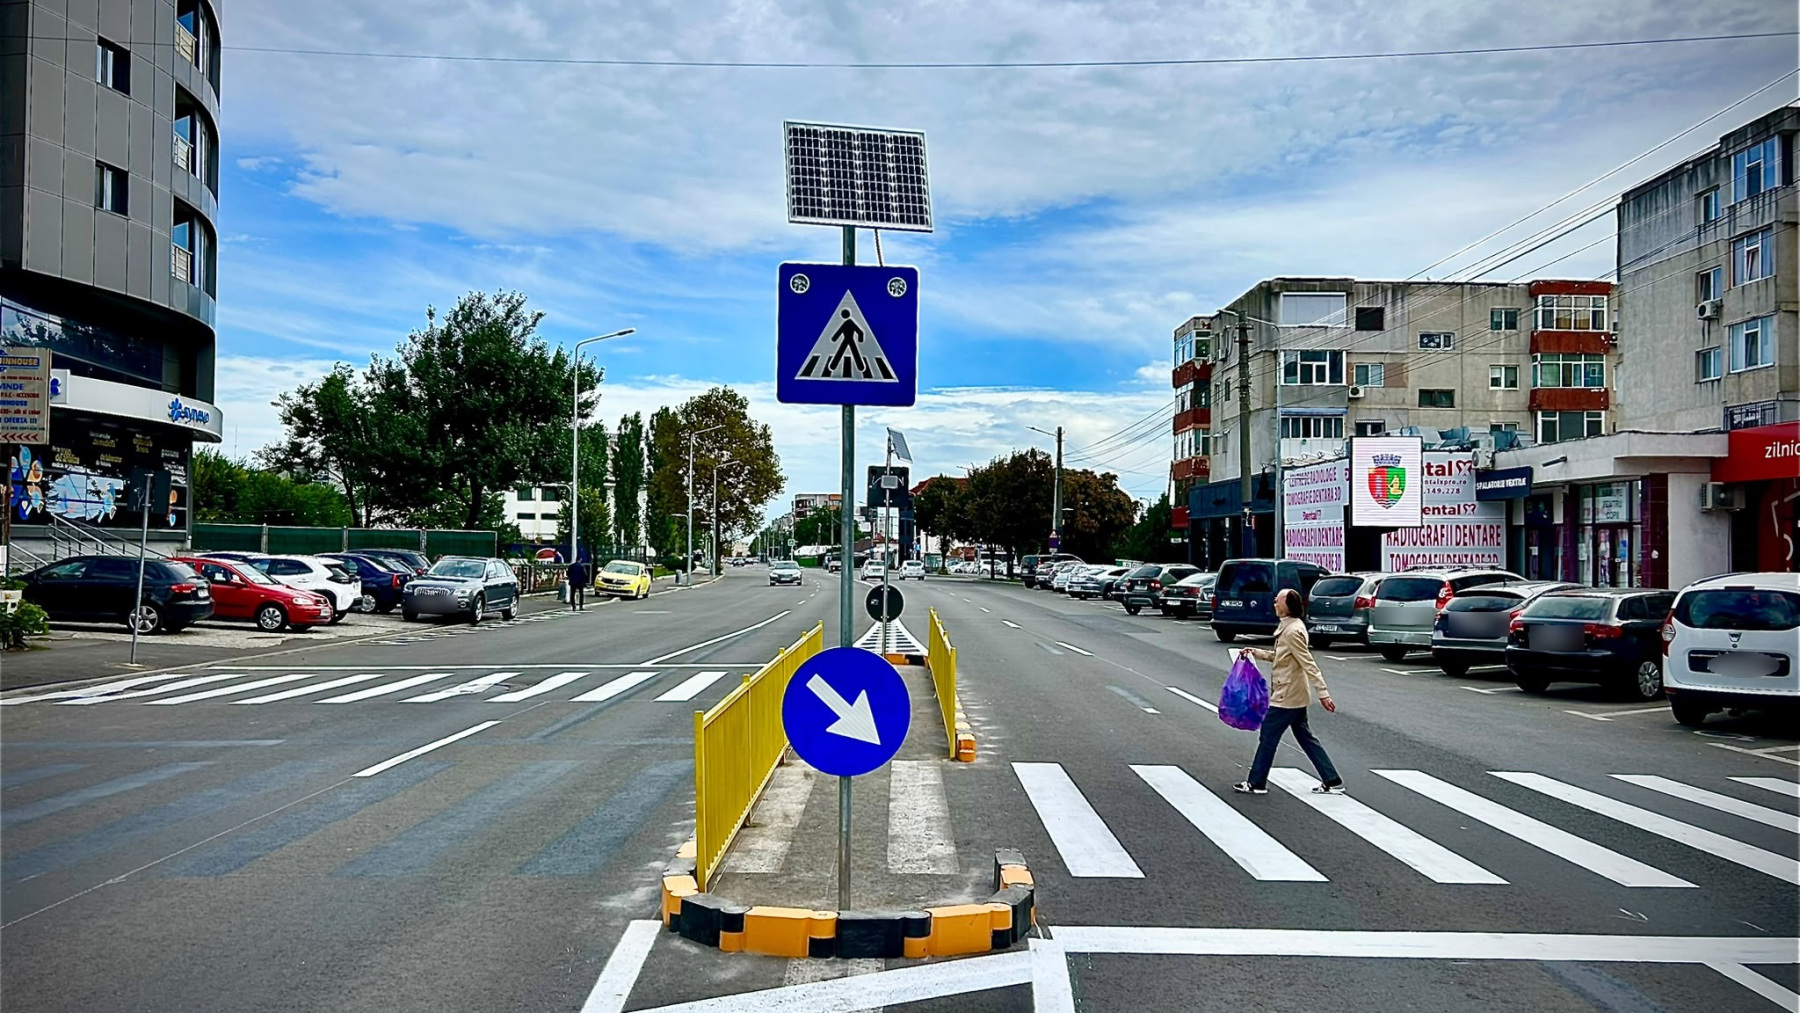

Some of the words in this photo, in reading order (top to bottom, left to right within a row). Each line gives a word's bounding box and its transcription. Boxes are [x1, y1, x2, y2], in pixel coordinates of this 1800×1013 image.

[0, 358, 37, 366] INHOUSE
[183, 407, 209, 424] synevo
[1765, 440, 1800, 458] zilnic
[1422, 504, 1460, 515] ental
[1286, 527, 1317, 547] RADIOGRAFII
[1317, 526, 1343, 546] DENTARE
[1386, 525, 1453, 546] RADIOGRAFII
[1455, 525, 1501, 546] DENTARE
